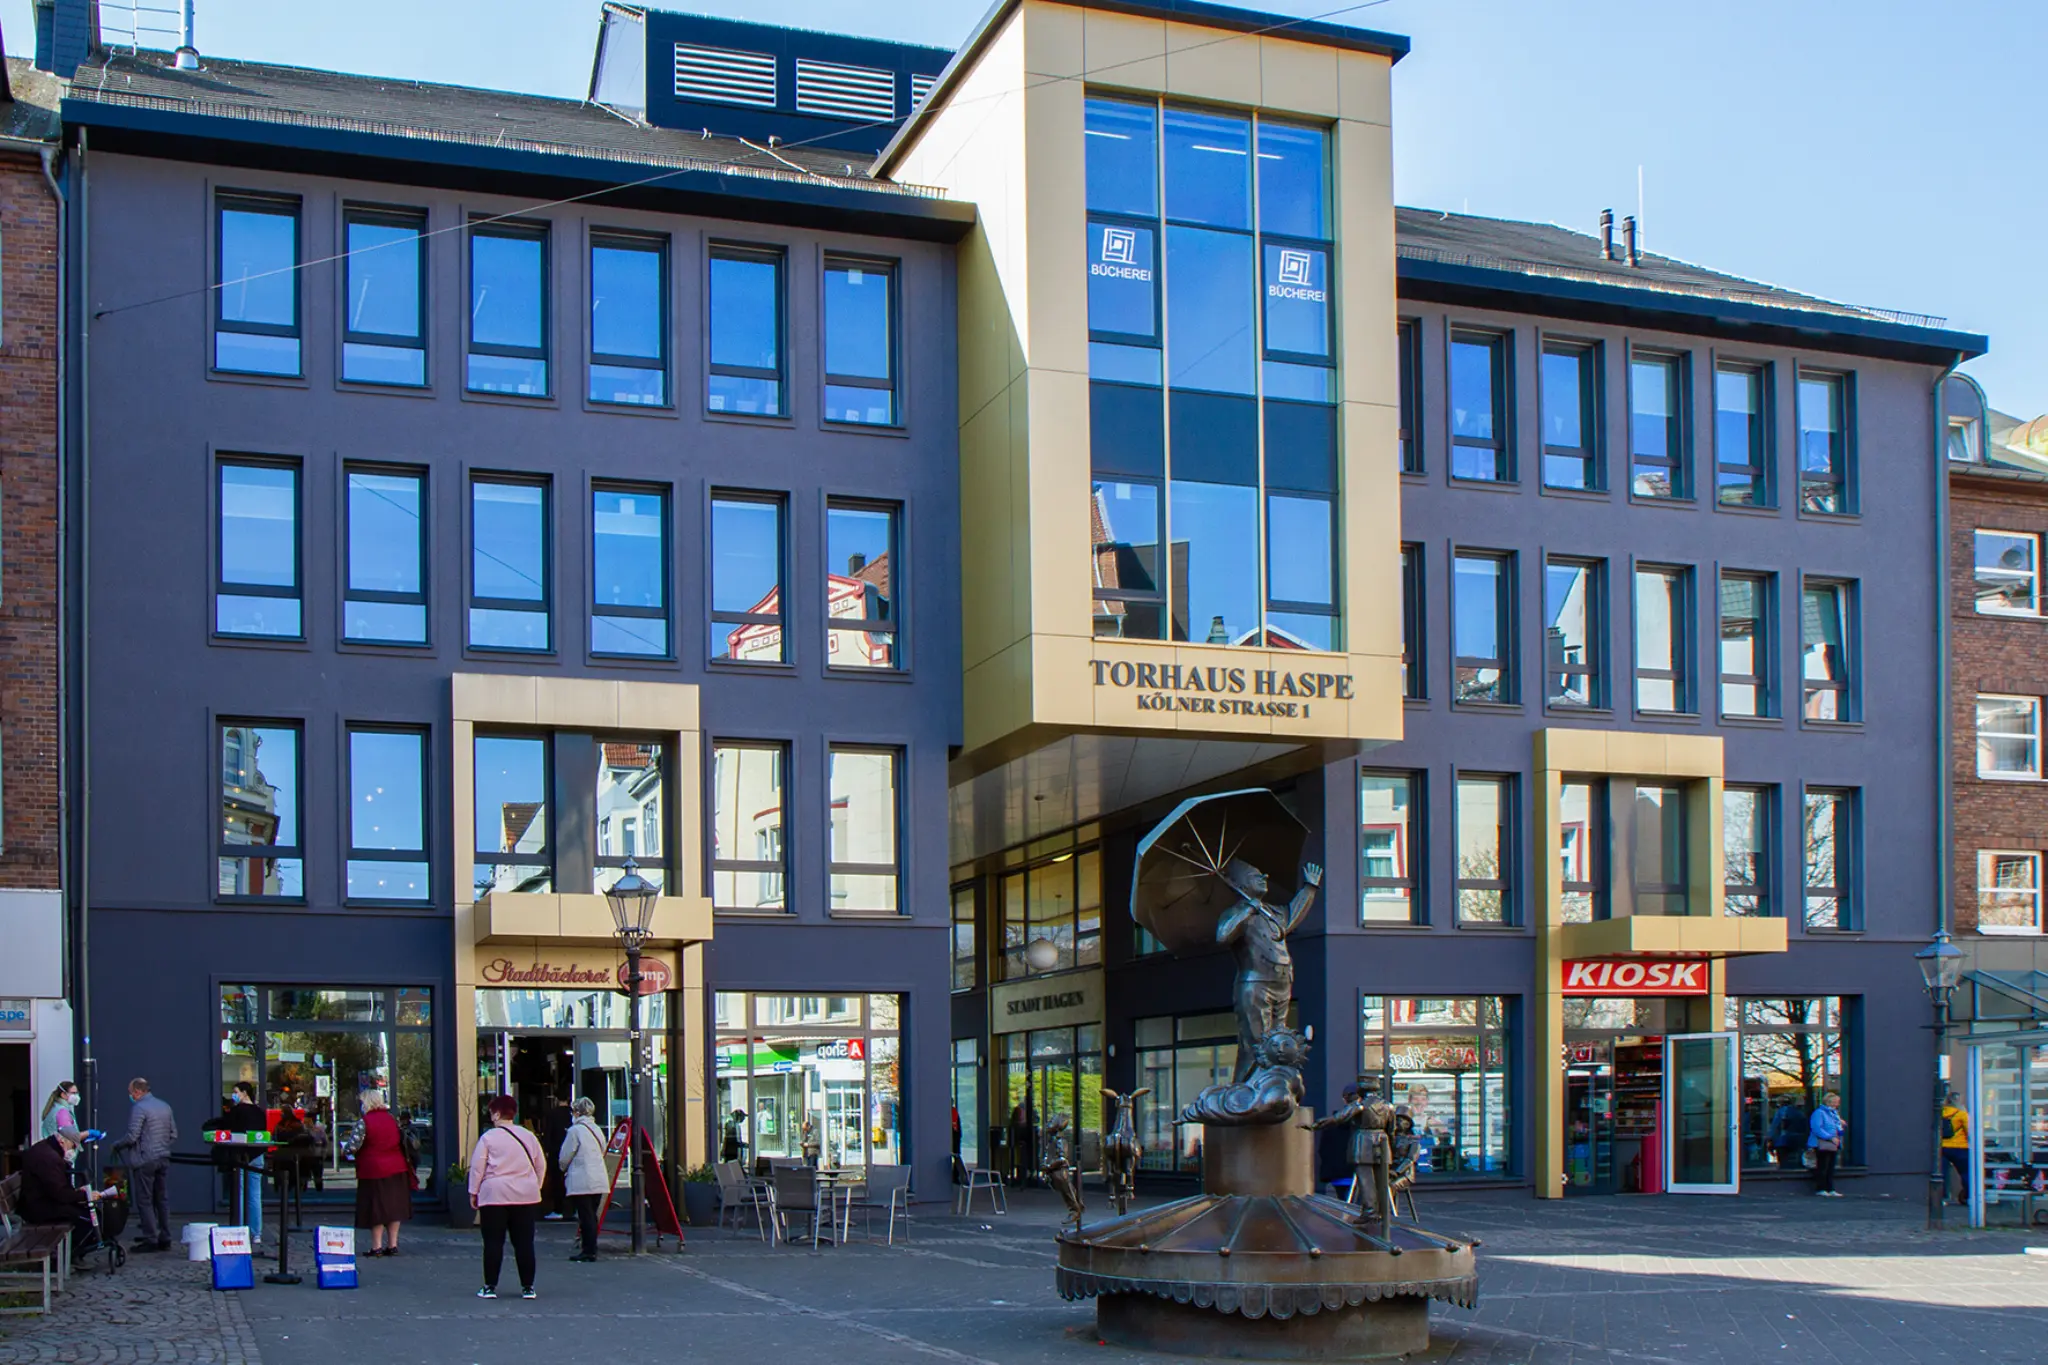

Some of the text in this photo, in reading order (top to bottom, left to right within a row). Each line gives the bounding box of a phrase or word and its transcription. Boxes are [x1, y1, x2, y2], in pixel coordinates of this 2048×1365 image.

[1091, 263, 1152, 282] BÜCHEREI
[1269, 284, 1325, 303] BÜCHEREI
[1089, 660, 1355, 700] TORHAUS HASPE
[1137, 692, 1311, 718] KÖLNER STRASSE 1
[482, 958, 610, 983] Stadtbäckerei
[1567, 963, 1702, 987] KIOSK
[1007, 998, 1041, 1016] STADT
